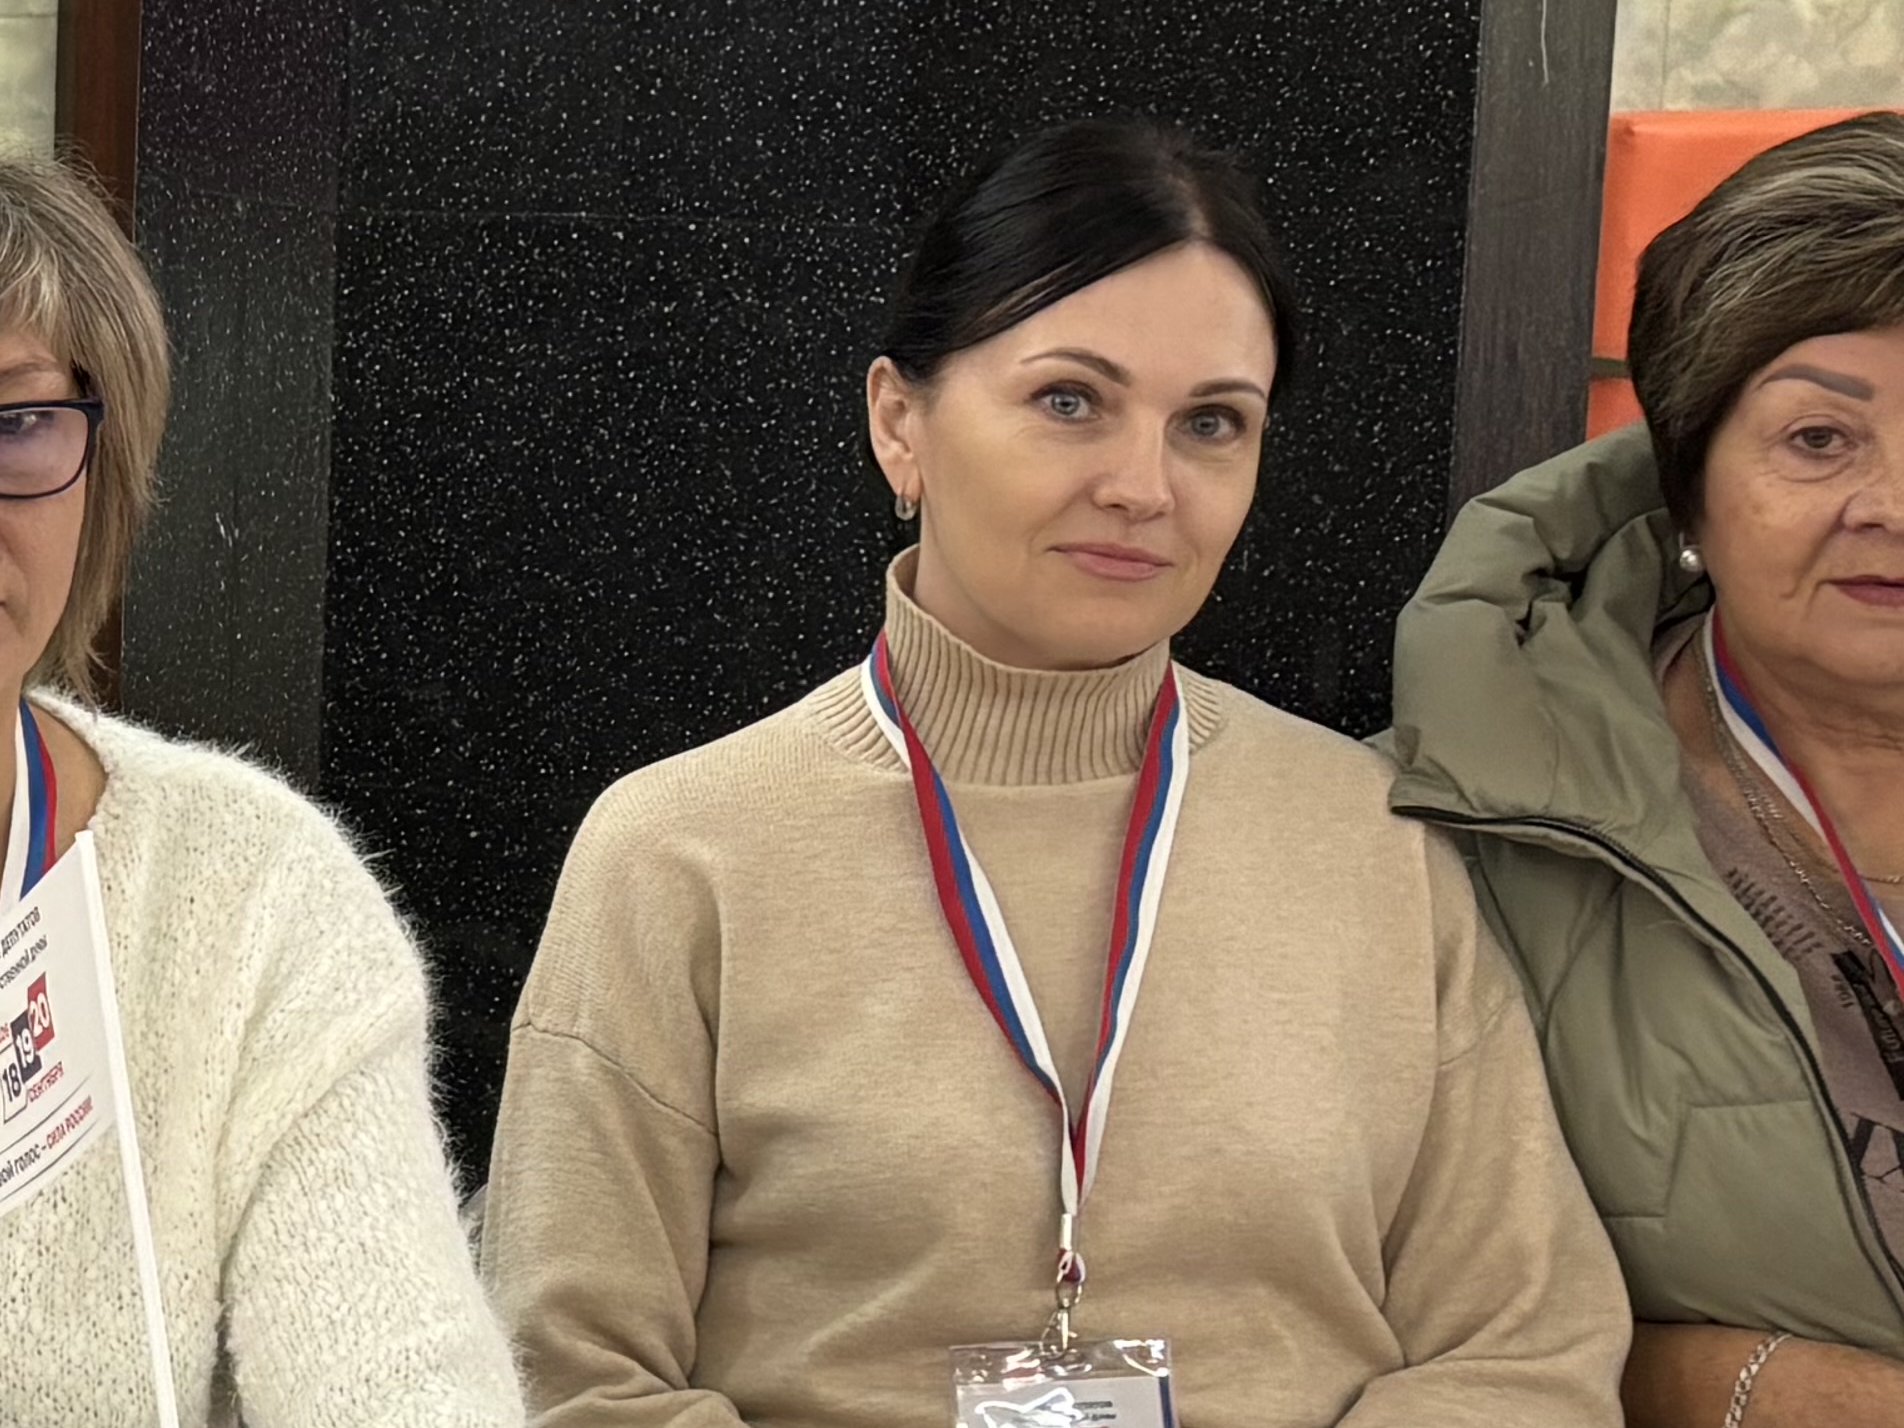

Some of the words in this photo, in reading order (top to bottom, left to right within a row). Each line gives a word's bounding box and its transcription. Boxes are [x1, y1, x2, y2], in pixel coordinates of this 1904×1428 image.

[0, 906, 41, 956] ДЕПУТАТОВ
[2, 1063, 22, 1103] 18
[15, 1027, 35, 1068] 19
[29, 992, 50, 1038] 20
[45, 1124, 66, 1150] СИЛА
